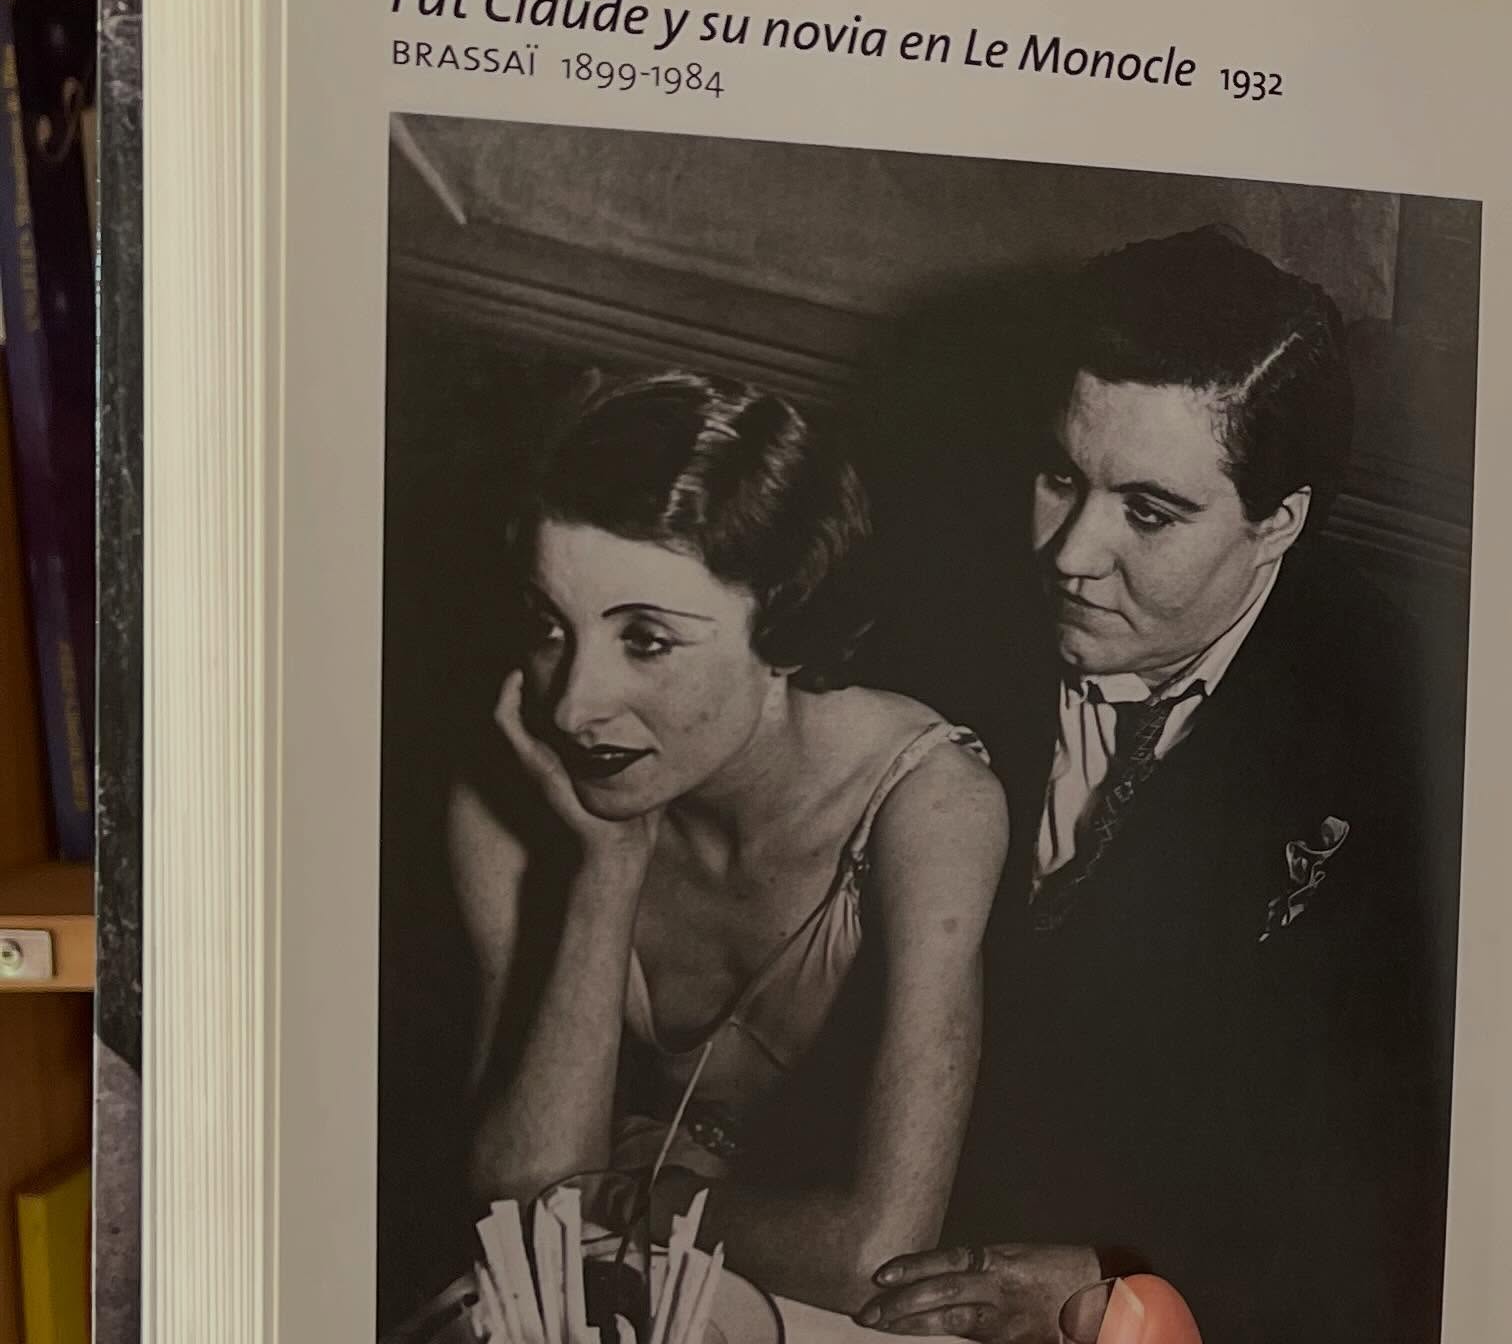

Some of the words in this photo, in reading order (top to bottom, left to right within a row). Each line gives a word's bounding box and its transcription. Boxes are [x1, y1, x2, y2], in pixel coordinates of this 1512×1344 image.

[392, 39, 535, 76] BRASSAÏ
[561, 52, 725, 99] 1899-1984
[652, 7, 691, 51] y
[699, 12, 751, 45] su
[762, 14, 888, 57] novia
[899, 31, 951, 64] en
[963, 28, 1009, 69] Le
[1017, 34, 1197, 87] Monocle
[1219, 68, 1283, 102] 1932
